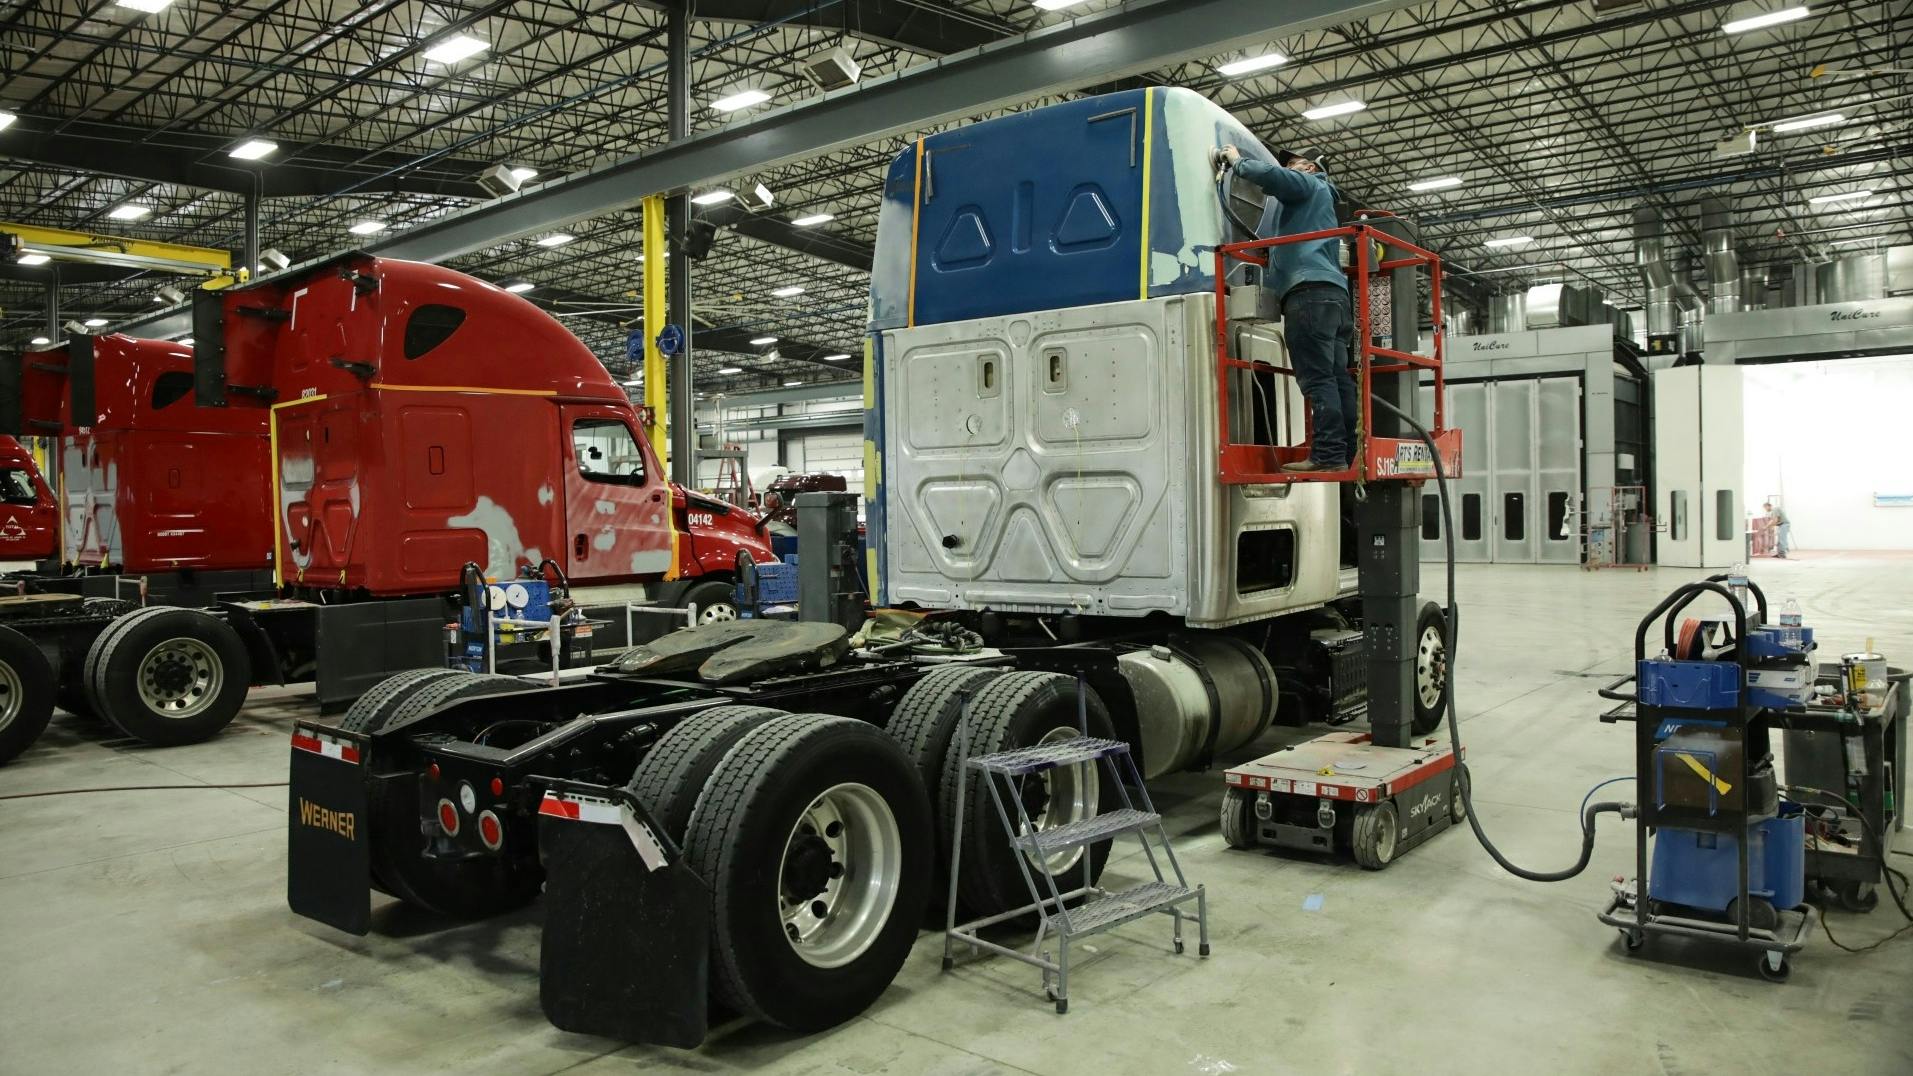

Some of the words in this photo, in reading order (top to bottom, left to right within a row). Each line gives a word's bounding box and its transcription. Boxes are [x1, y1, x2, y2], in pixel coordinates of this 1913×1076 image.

[1830, 309, 1881, 321] UniCure
[1472, 340, 1510, 351] UniCure
[1413, 445, 1432, 462] RENTA
[688, 513, 713, 526] 04142
[1410, 792, 1442, 818] SKYJACK
[299, 796, 355, 841] WERNER
